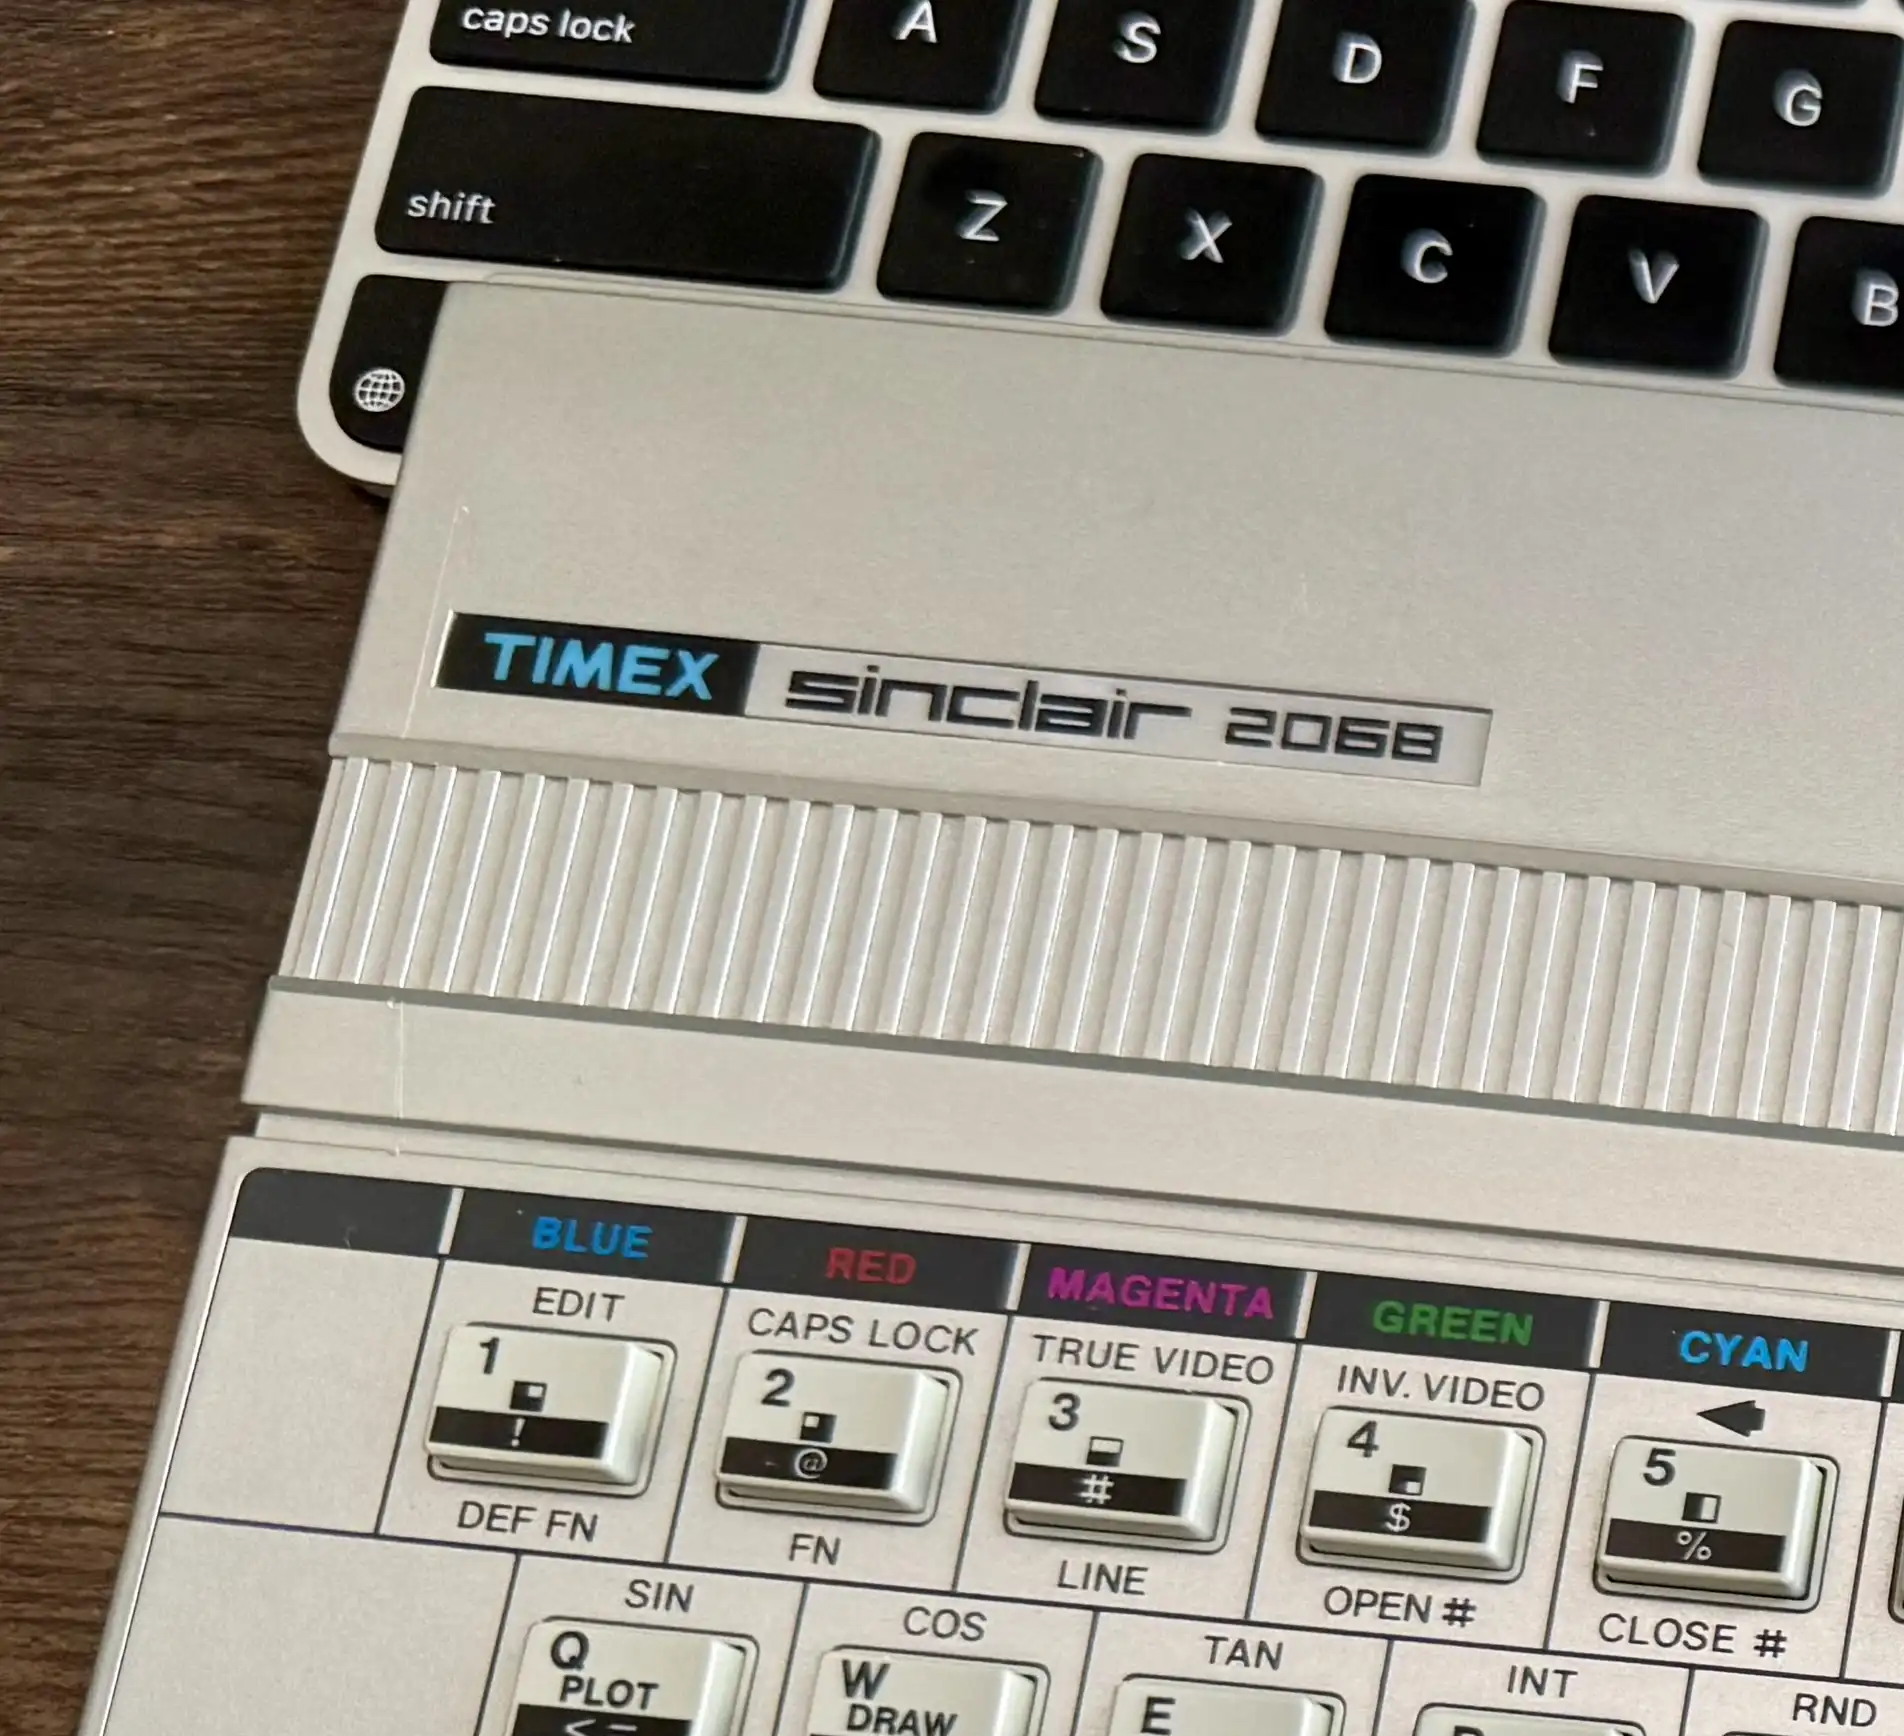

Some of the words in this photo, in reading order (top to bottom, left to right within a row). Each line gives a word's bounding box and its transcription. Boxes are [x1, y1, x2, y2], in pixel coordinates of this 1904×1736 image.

[462, 4, 552, 40] caps
[560, 11, 634, 42] lock
[895, 0, 937, 44] A
[1114, 19, 1161, 64] S
[1334, 34, 1382, 84] D
[1558, 52, 1602, 103] F
[1774, 69, 1823, 128] G
[408, 192, 494, 223] shift
[960, 194, 1006, 242] Z
[1180, 211, 1231, 265] X
[1403, 230, 1453, 283] C
[1628, 246, 1680, 304] V
[1853, 270, 1898, 326] B
[486, 633, 717, 699] TIMEX
[786, 665, 1191, 739] sinclair
[1225, 708, 1442, 762] 2068
[534, 1214, 650, 1258] BLUE
[828, 1248, 913, 1283] RED
[532, 1287, 624, 1321] EDIT
[1049, 1268, 1272, 1318] MAGENTA
[748, 1308, 853, 1343] CAPS
[868, 1320, 978, 1355] LOCK
[1375, 1300, 1532, 1345] GREEN
[1033, 1334, 1139, 1371] TRUE
[1156, 1347, 1273, 1384] VIDEO
[1681, 1331, 1807, 1371] CYAN
[1338, 1365, 1409, 1398] INV.
[1425, 1373, 1544, 1411] VIDEO
[458, 1501, 536, 1532] DEF
[546, 1510, 597, 1541] FN
[790, 1534, 839, 1564] FN
[625, 1580, 693, 1612] SIN
[1057, 1561, 1148, 1595] LINE
[904, 1607, 986, 1641] COS
[1204, 1636, 1282, 1670] TAN
[560, 1676, 658, 1709] PLOT
[1508, 1666, 1578, 1697] INT
[1793, 1693, 1876, 1726] RND
